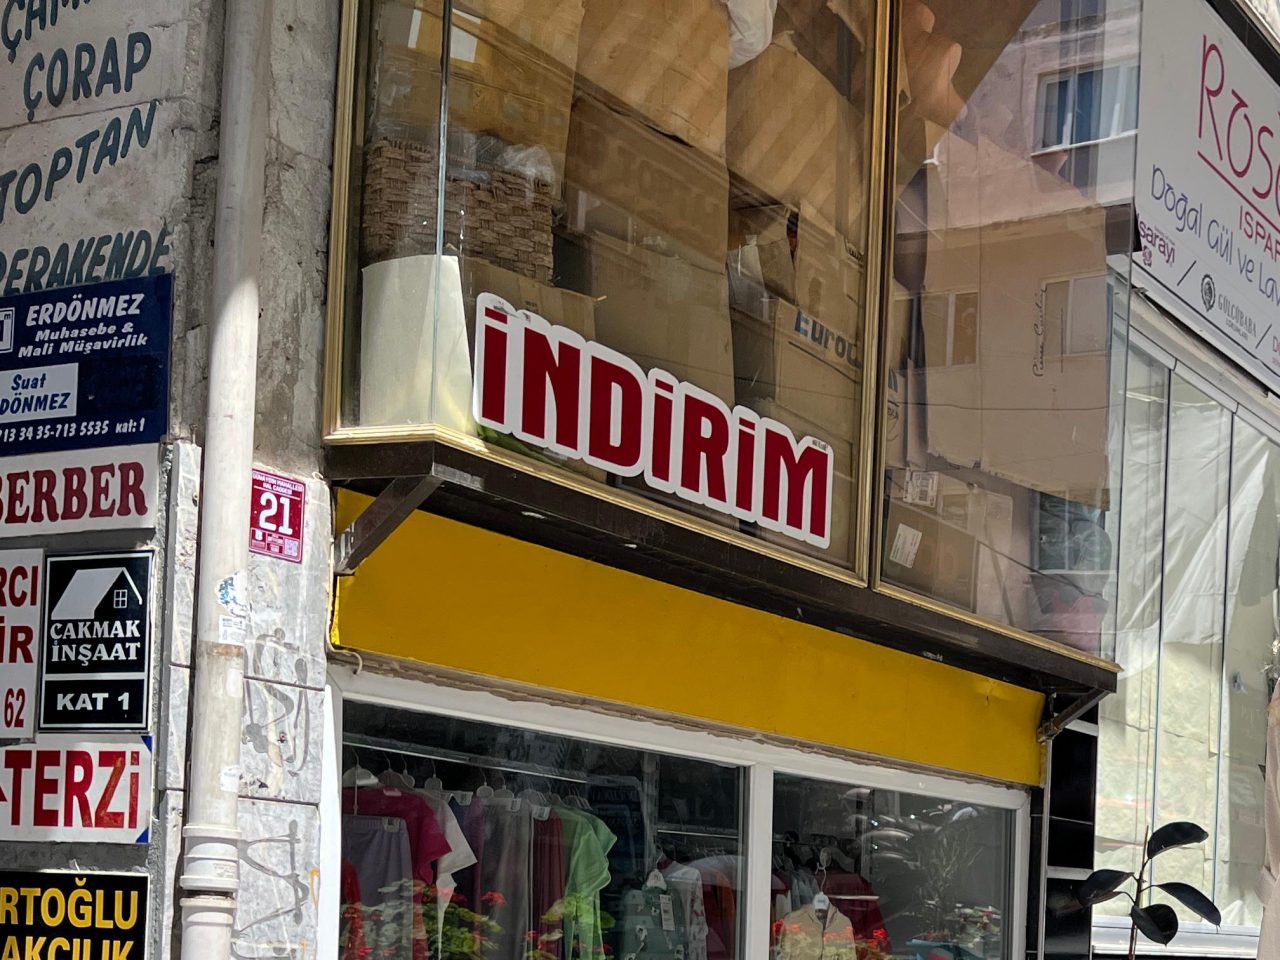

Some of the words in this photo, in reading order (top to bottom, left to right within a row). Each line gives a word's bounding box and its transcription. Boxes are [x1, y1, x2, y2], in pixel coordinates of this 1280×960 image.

[24, 31, 152, 122] ÇORAP
[0, 99, 157, 224] TOPTAN
[1151, 164, 1202, 238] Doğal
[1207, 219, 1233, 265] Gül
[1237, 247, 1255, 283] ve
[26, 293, 144, 326] ERDÖNMEZ
[18, 343, 54, 358] Mali
[59, 334, 148, 355] Müşavirlik
[35, 323, 116, 341] Muhasebe
[121, 322, 133, 333] &
[11, 373, 46, 391] Suat
[19, 427, 33, 440] 34
[80, 420, 109, 436] 5535
[140, 417, 145, 432] 1
[0, 461, 148, 525] ERBER
[259, 491, 293, 535] 21
[51, 641, 141, 666] İNŞAAT
[4, 687, 25, 728] 62
[57, 692, 109, 711] KAT
[118, 692, 129, 711] 1
